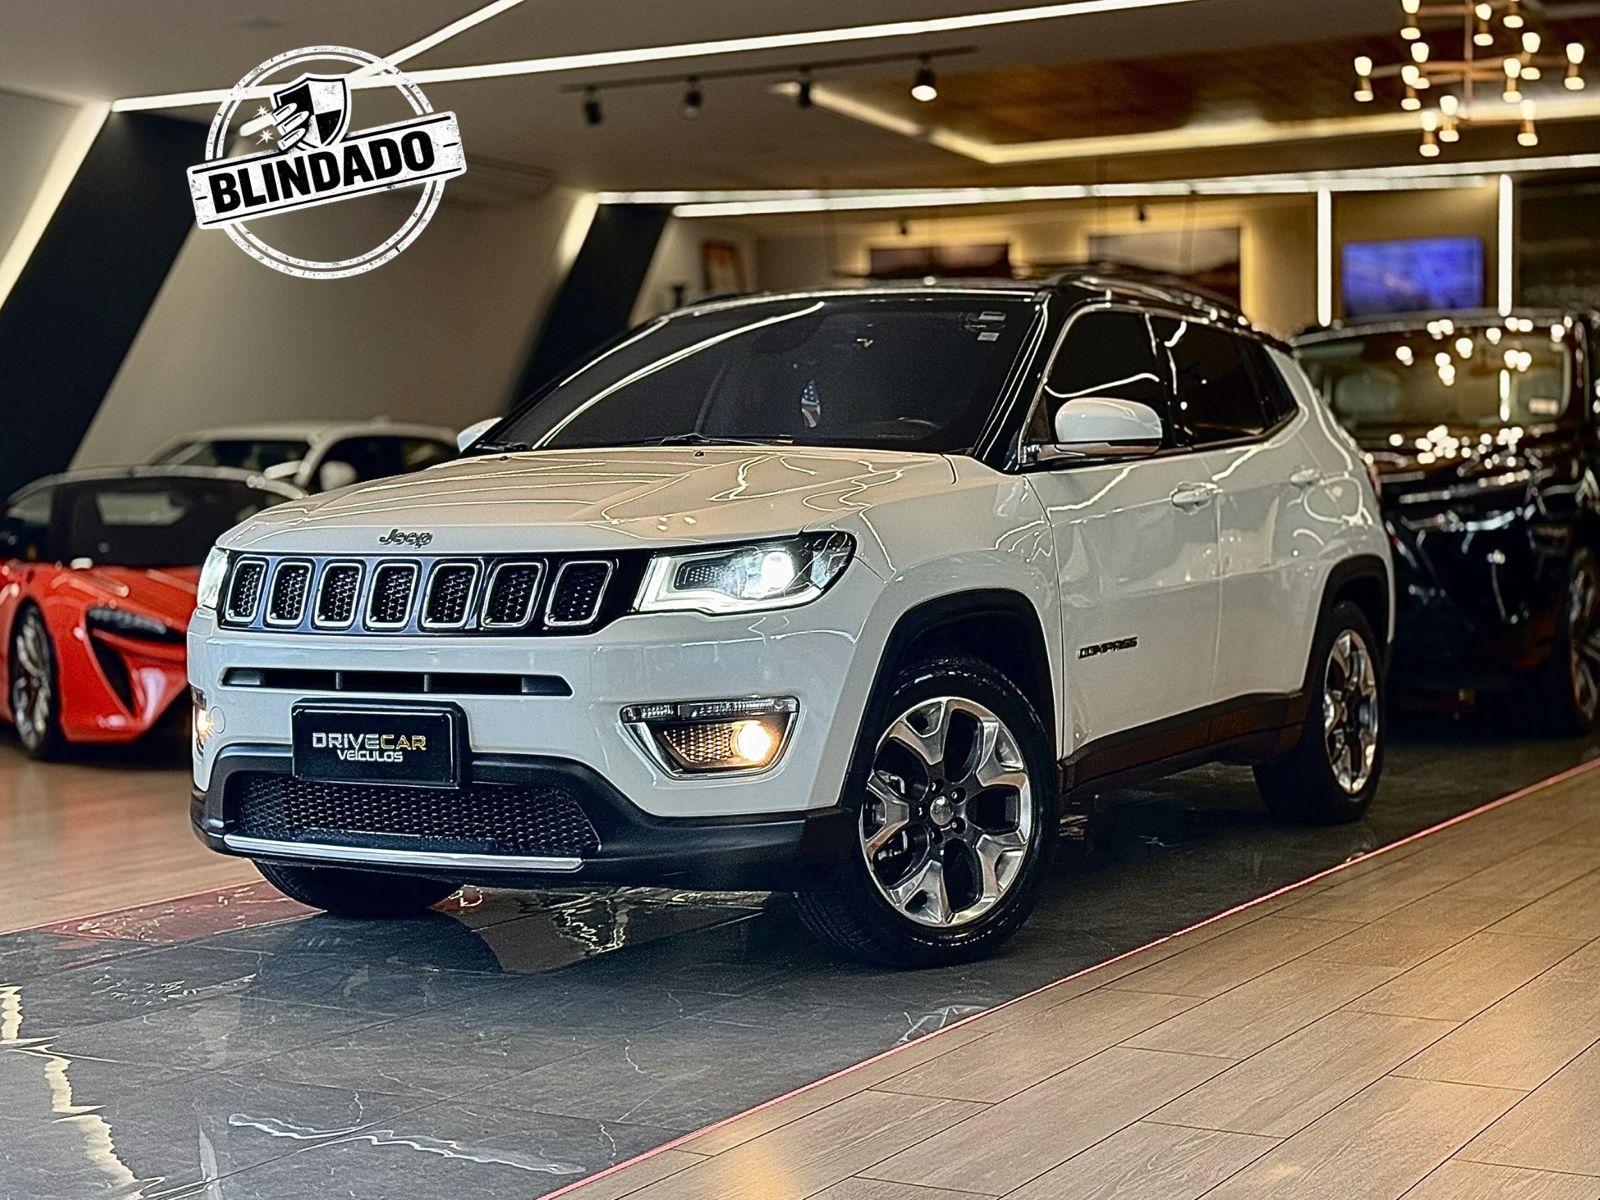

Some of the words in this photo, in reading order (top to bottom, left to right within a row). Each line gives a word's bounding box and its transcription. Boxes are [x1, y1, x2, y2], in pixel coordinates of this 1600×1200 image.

[378, 528, 433, 549] Jeep
[1077, 636, 1138, 660] COMPASS
[312, 732, 427, 751] DRIVECAR
